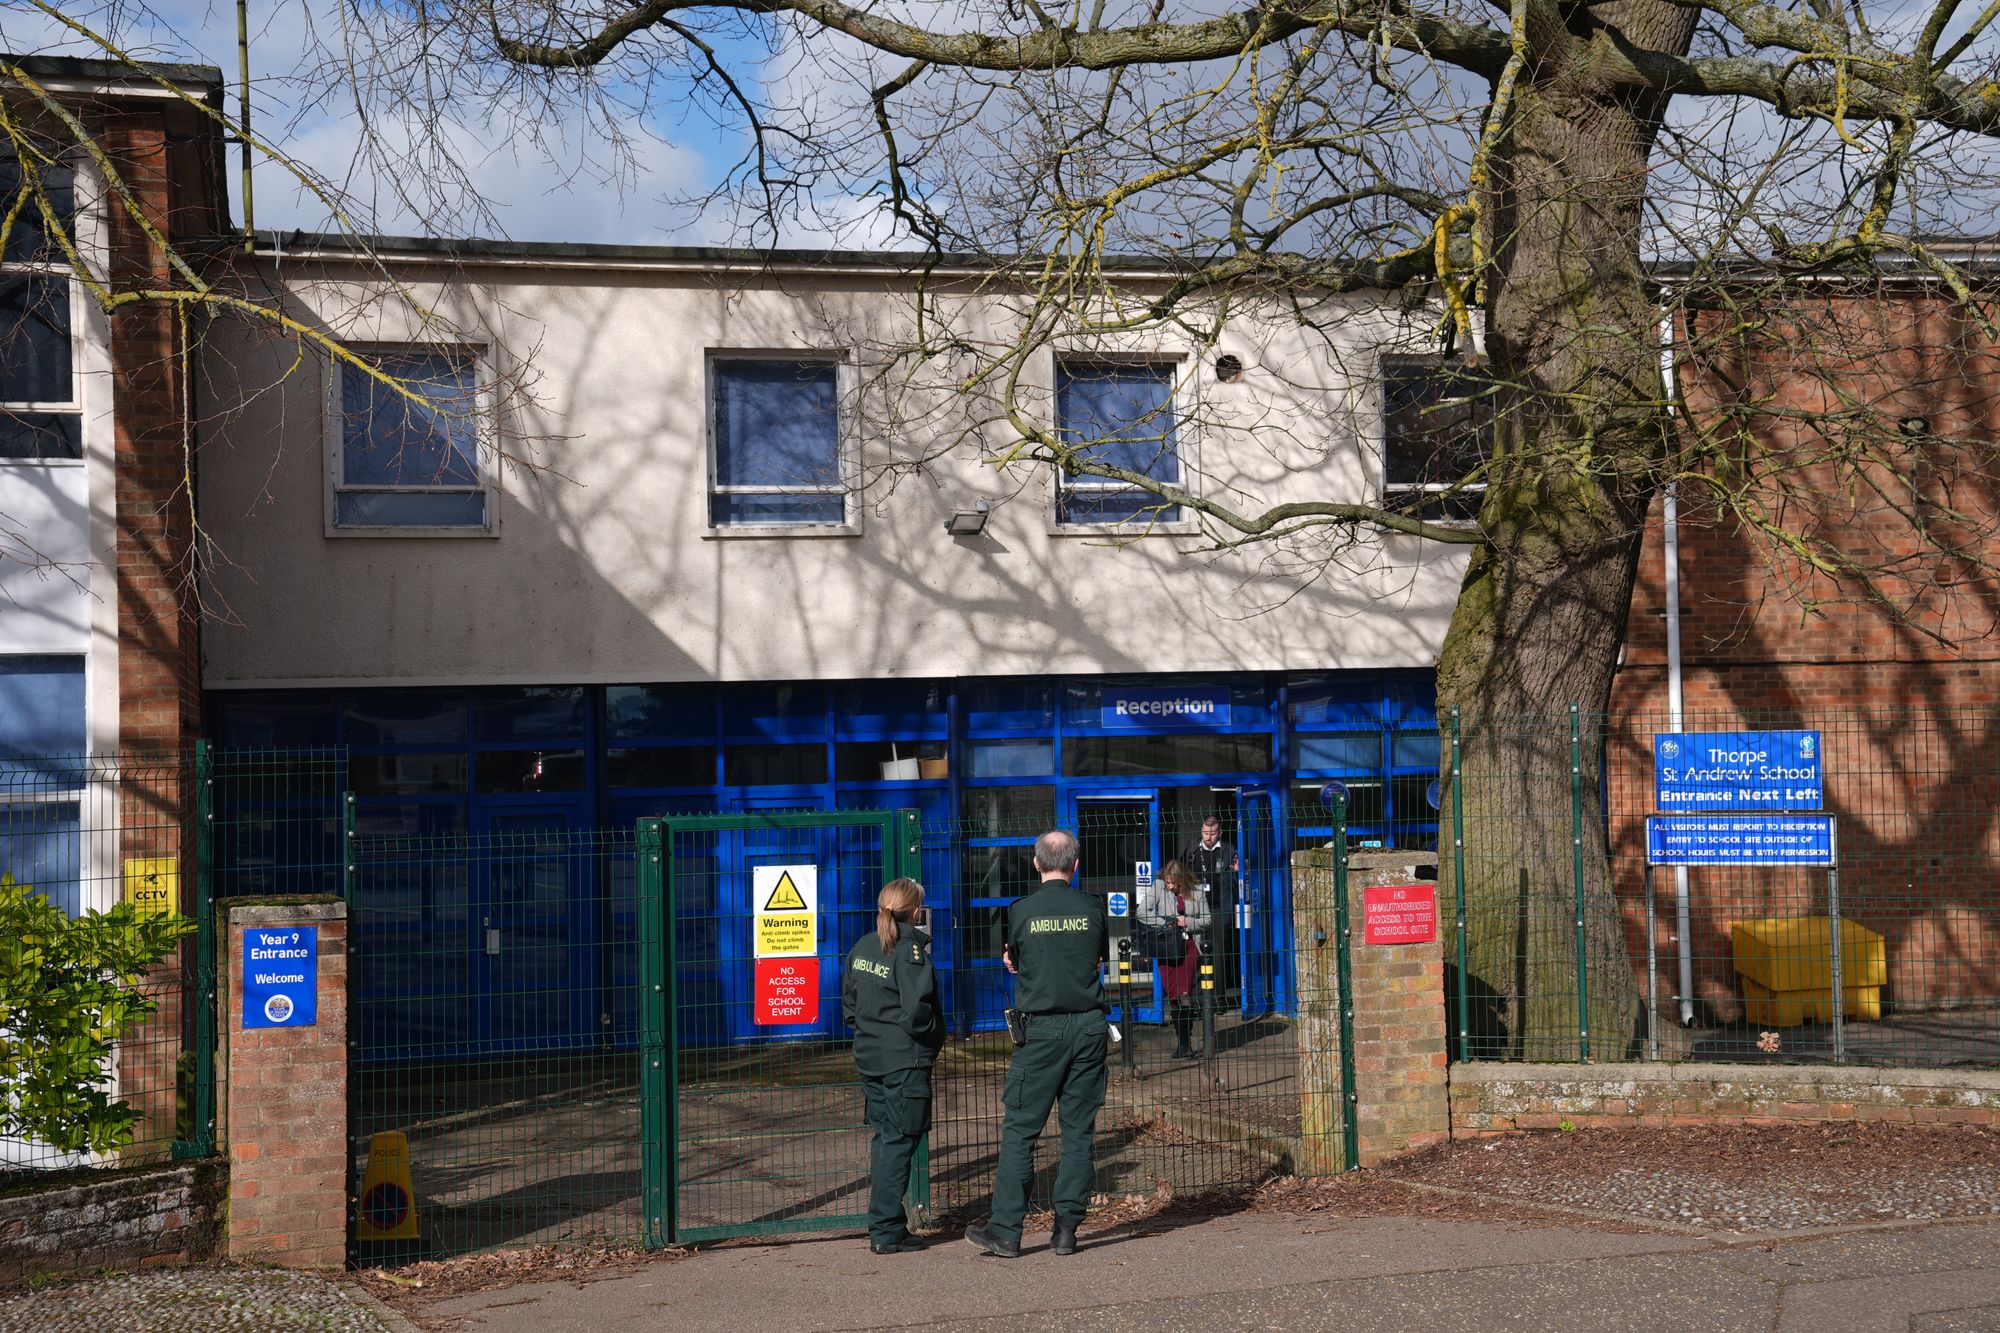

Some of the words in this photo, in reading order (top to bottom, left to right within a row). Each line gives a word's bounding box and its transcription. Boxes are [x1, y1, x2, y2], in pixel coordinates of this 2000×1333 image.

[1116, 697, 1214, 716] Reception
[1708, 748, 1767, 766] Thorpe
[1663, 767, 1678, 782] St
[1685, 766, 1753, 781] Andrew
[1760, 765, 1816, 780] School
[1660, 790, 1733, 802] Entrance
[1739, 789, 1779, 801] Next
[1786, 788, 1819, 800] Left
[1654, 823, 1669, 831] ALL
[1672, 823, 1706, 831] VISITORS
[1708, 823, 1730, 831] MUST
[1733, 823, 1764, 831] REPORT
[1781, 823, 1826, 831] RECEPTION
[1667, 836, 1692, 844] ENTRY
[1695, 836, 1706, 844] TO
[1709, 836, 1741, 844] SCHOOL
[135, 890, 168, 900] CCTV
[1393, 890, 1407, 900] NO
[1368, 901, 1432, 912] UNAUTHORISED
[763, 918, 809, 929] Warning
[1368, 914, 1401, 925] ACCESS
[1403, 914, 1415, 923] TO
[1416, 913, 1433, 922] THE
[1030, 917, 1089, 934] AMBULANCE
[1374, 926, 1410, 936] SCHOOL
[1411, 924, 1429, 934] SITE
[259, 934, 289, 945] Year
[292, 933, 300, 944] 9
[251, 947, 308, 960] Entrance
[780, 966, 794, 976] NO
[852, 958, 891, 979] AMBULANCE
[255, 972, 304, 984] Welcome
[768, 976, 806, 986] ACCESS
[776, 987, 795, 996] FOR
[768, 997, 806, 1006] SCHOOL
[771, 1007, 802, 1017] EVENT
[374, 1149, 401, 1157] POLICE
